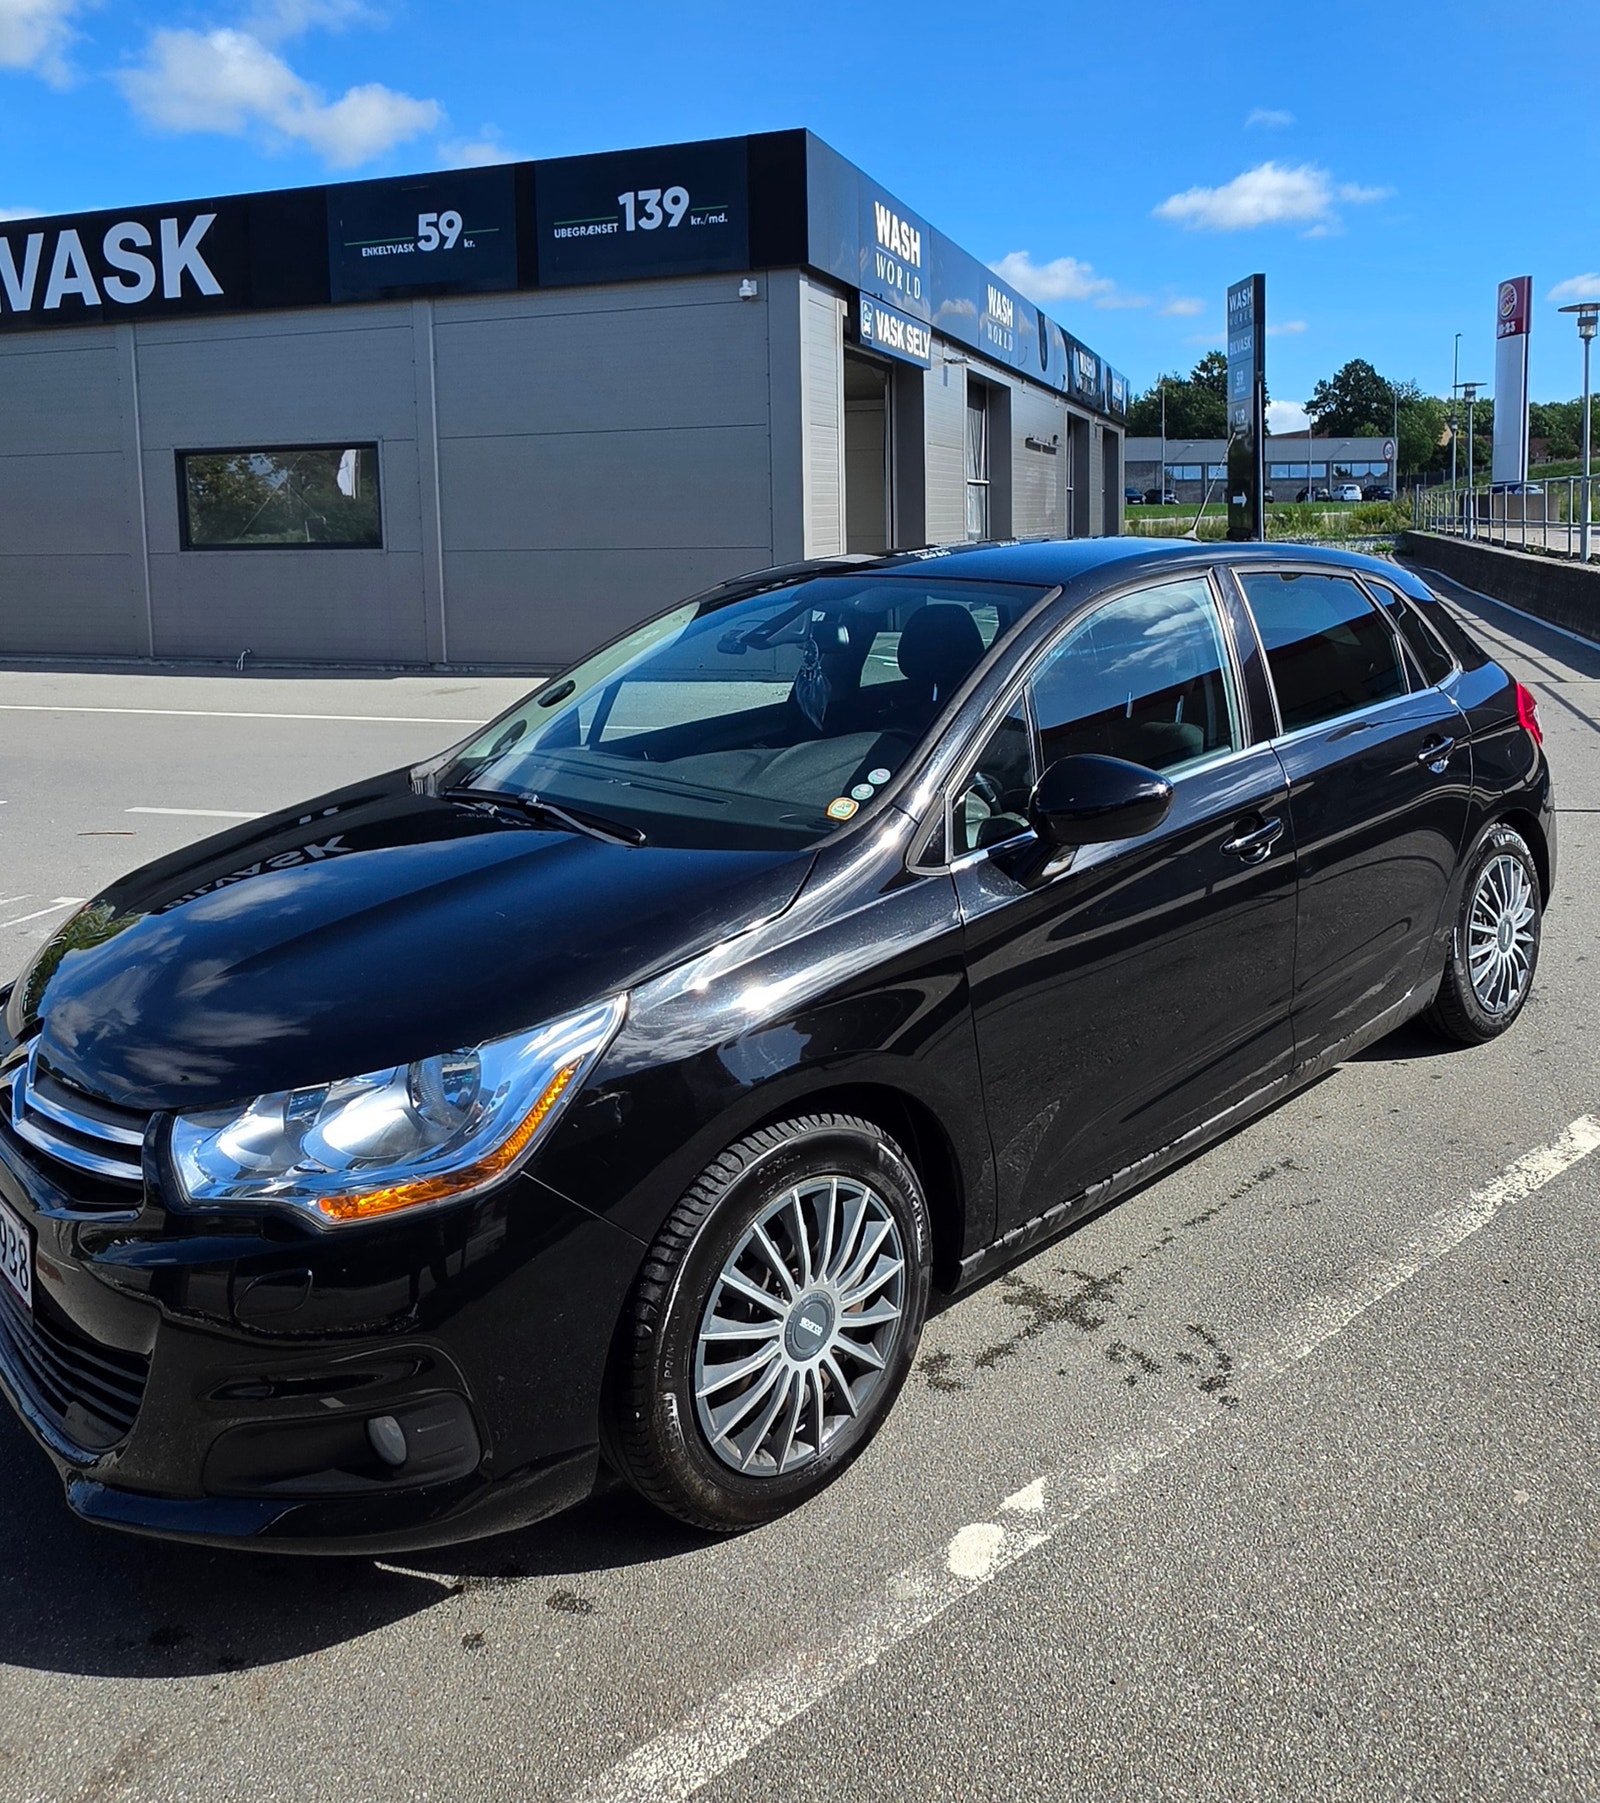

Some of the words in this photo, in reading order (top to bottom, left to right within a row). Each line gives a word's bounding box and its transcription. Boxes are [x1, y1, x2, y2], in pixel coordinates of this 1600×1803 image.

[361, 243, 415, 257] ENKELTVASK
[417, 210, 463, 252] 59
[463, 238, 476, 248] kr.
[554, 223, 619, 238] UBEGRÆNSET
[617, 186, 690, 231] 139
[690, 212, 728, 226] kr./md.
[874, 201, 921, 268] WASH
[875, 252, 921, 300] WORLD
[987, 284, 1014, 328] WASH
[1229, 285, 1253, 313] WASH
[875, 309, 905, 350] VASK
[987, 321, 1014, 352] WORLD
[799, 1316, 823, 1334] sparco
